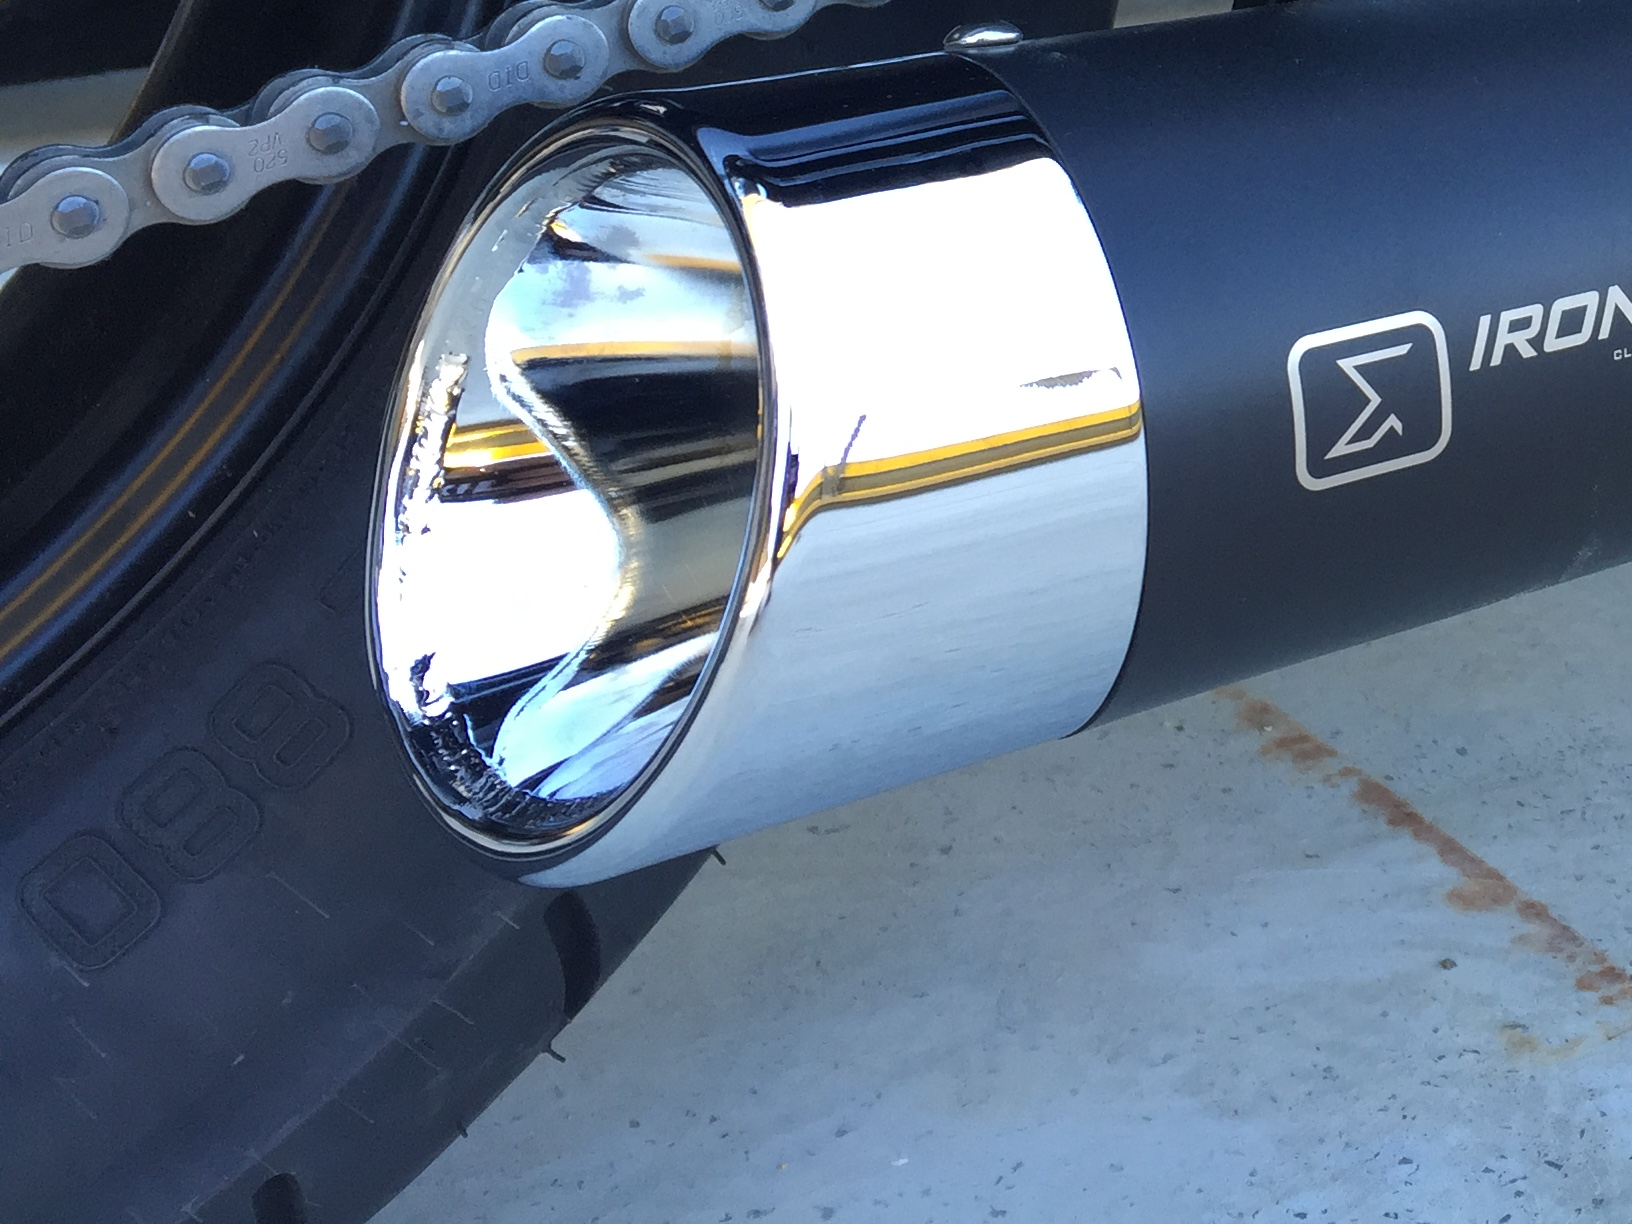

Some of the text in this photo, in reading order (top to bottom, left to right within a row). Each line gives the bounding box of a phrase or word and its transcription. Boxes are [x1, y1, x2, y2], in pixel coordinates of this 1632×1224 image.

[487, 60, 530, 92] DID
[253, 148, 289, 173] 520
[16, 660, 354, 971] 880
